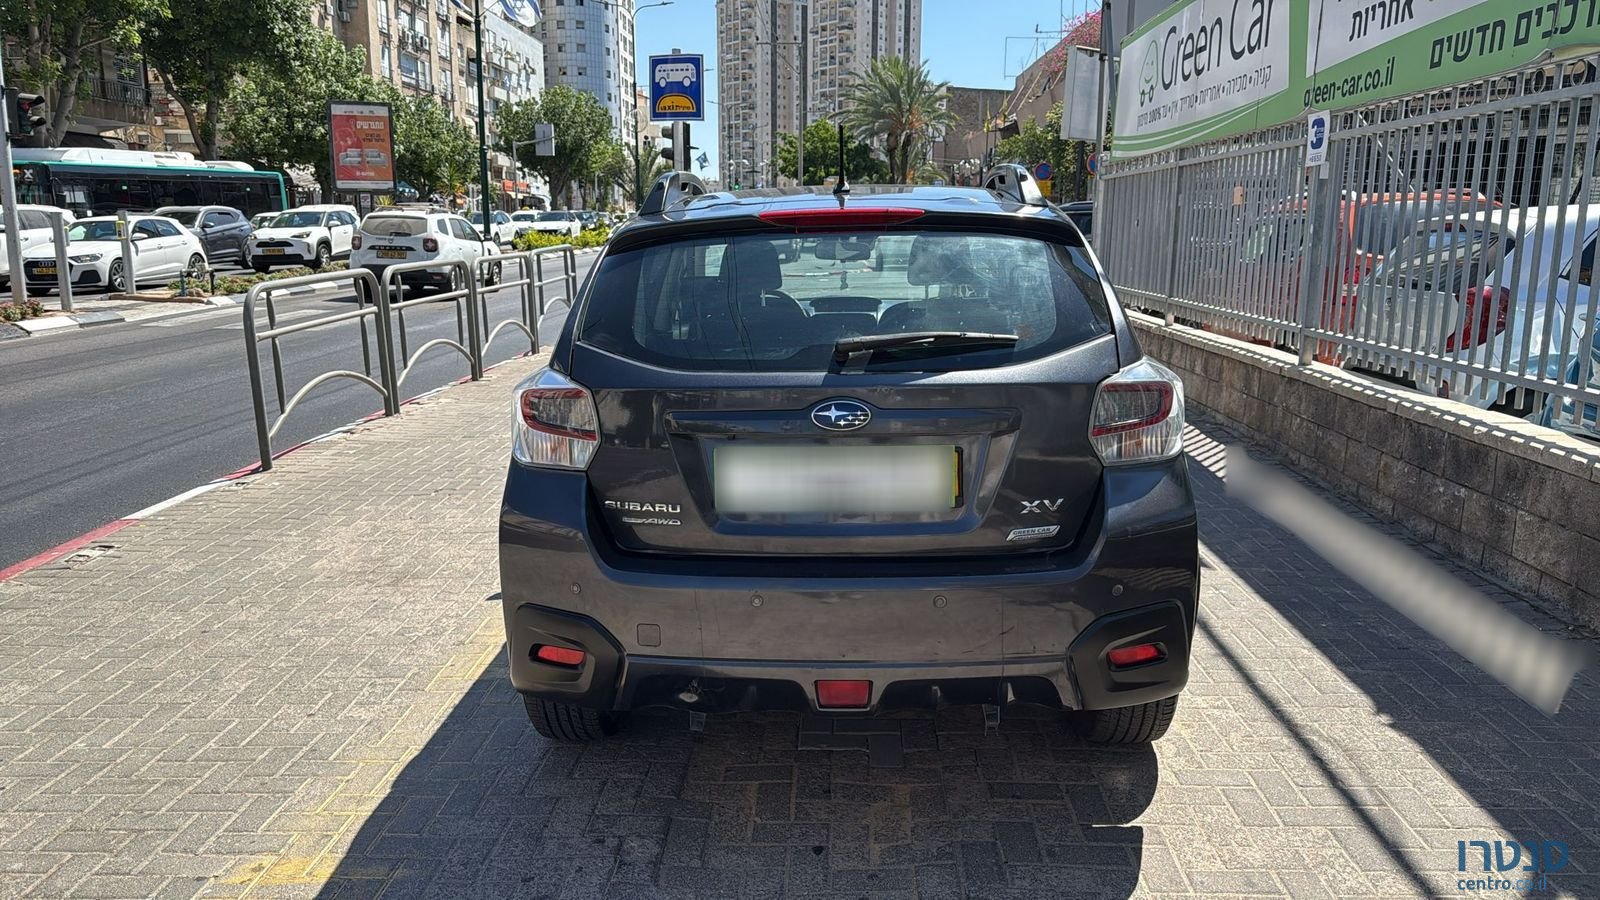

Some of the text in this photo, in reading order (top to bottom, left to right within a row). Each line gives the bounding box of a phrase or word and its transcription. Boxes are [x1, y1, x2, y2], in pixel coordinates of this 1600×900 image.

[1348, 0, 1414, 42] אחריות
[1161, 0, 1274, 91] Green Car
[1429, 19, 1506, 70] חדשים
[1226, 73, 1248, 96] מכירה
[1252, 65, 1272, 88] קניה
[1303, 56, 1396, 107] green-car.co.il
[604, 500, 681, 513] SUBARU
[1020, 498, 1064, 514] XV
[644, 518, 681, 526] AWD
